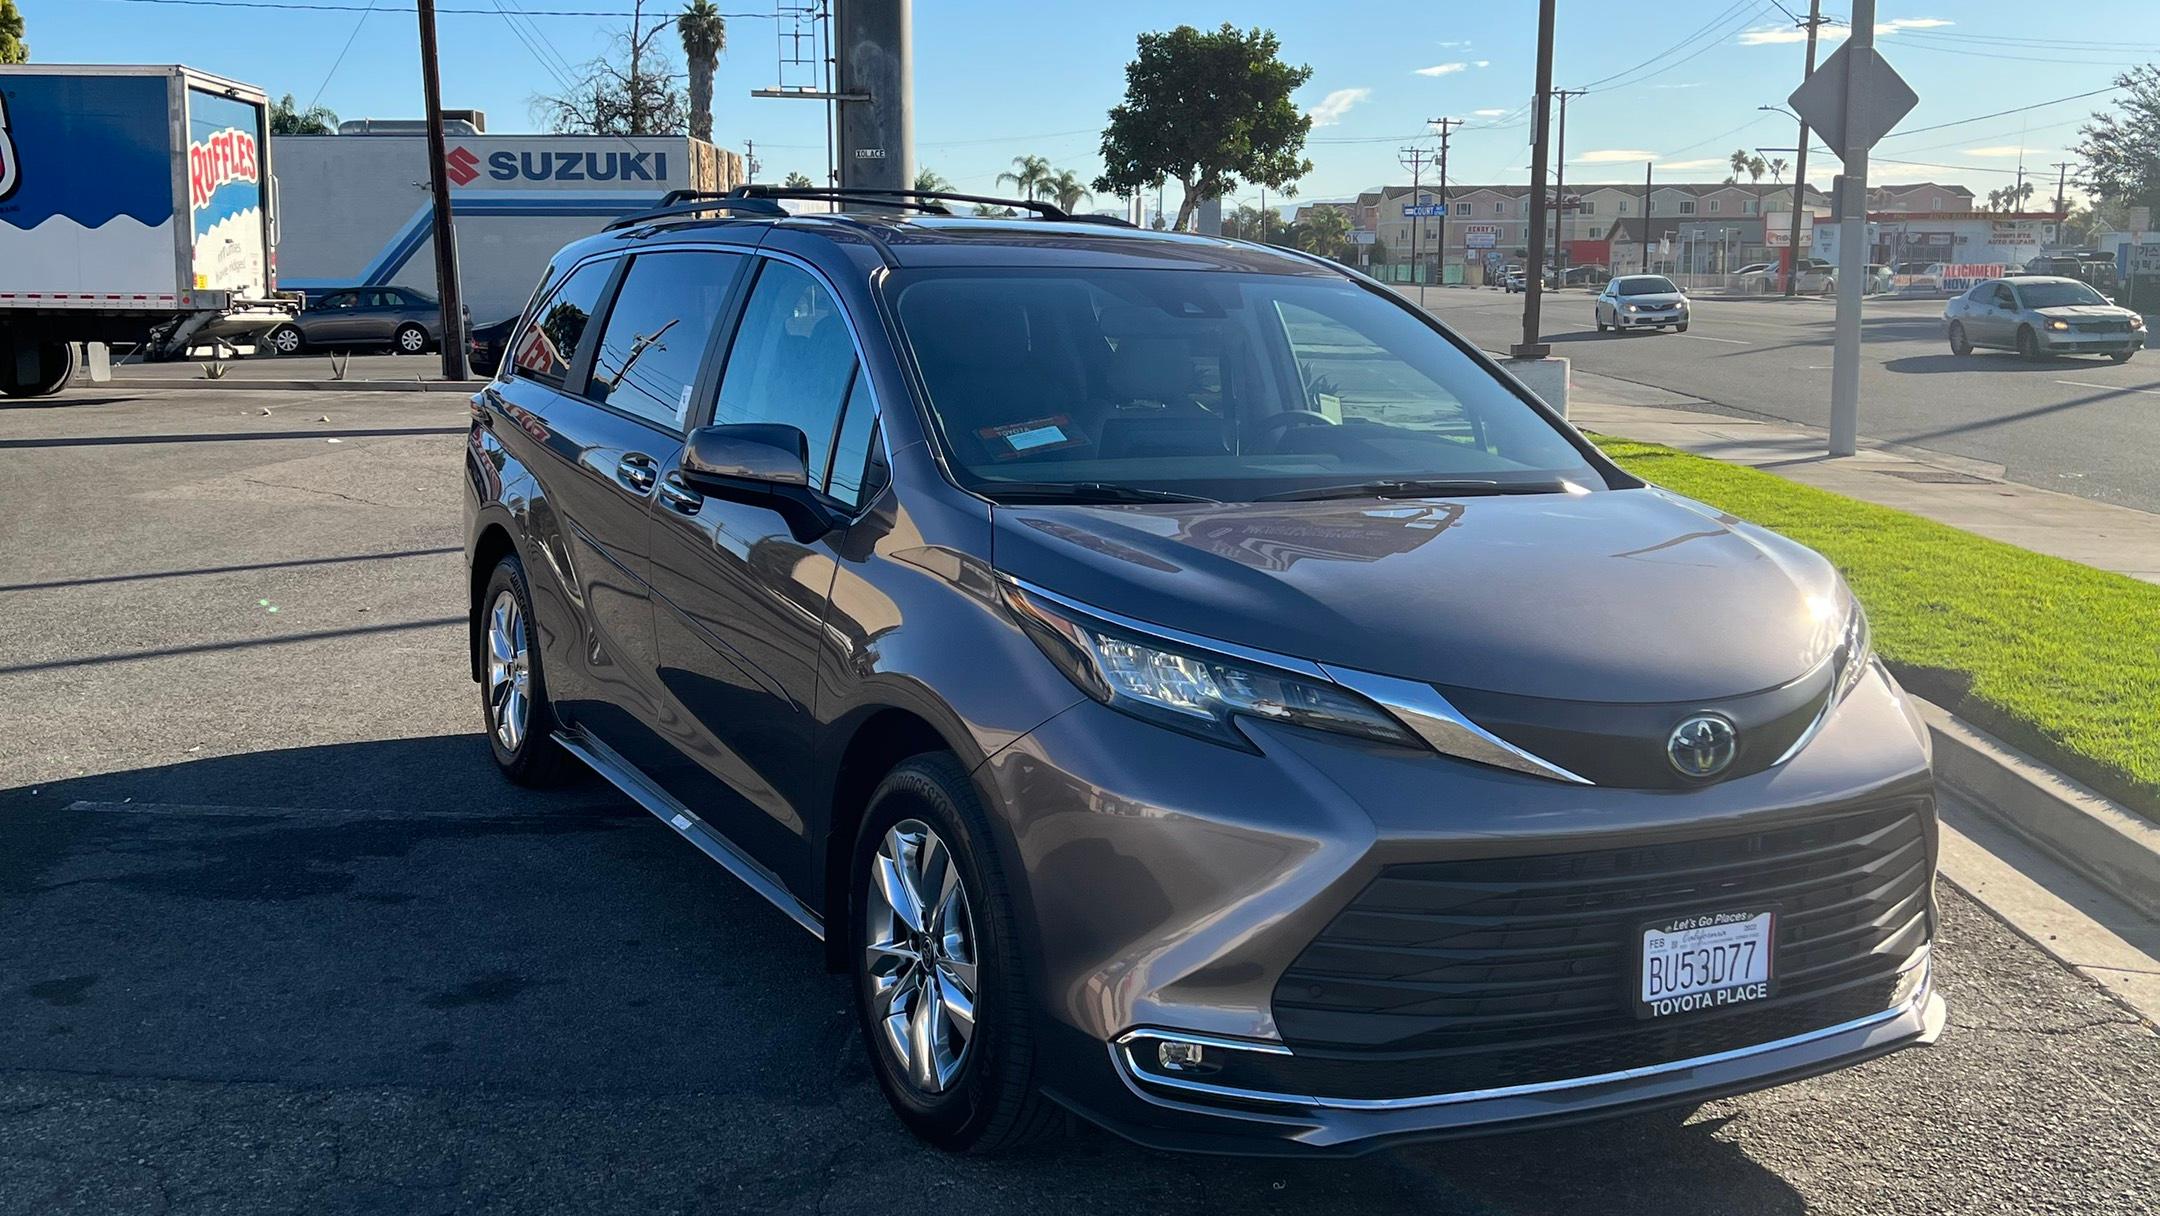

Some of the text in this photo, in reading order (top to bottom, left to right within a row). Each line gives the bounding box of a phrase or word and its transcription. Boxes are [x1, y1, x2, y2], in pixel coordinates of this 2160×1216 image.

[191, 132, 256, 206] RUFFLES
[488, 151, 667, 181] SUZUKI
[1944, 264, 2004, 278] ALIGNMENT
[1943, 278, 1970, 289] NOW
[1673, 912, 1748, 931] Let's Go Places
[1682, 930, 1727, 945] California
[1649, 940, 1757, 996] BU53D77
[1651, 983, 1767, 1017] TOYOTA PLACE
